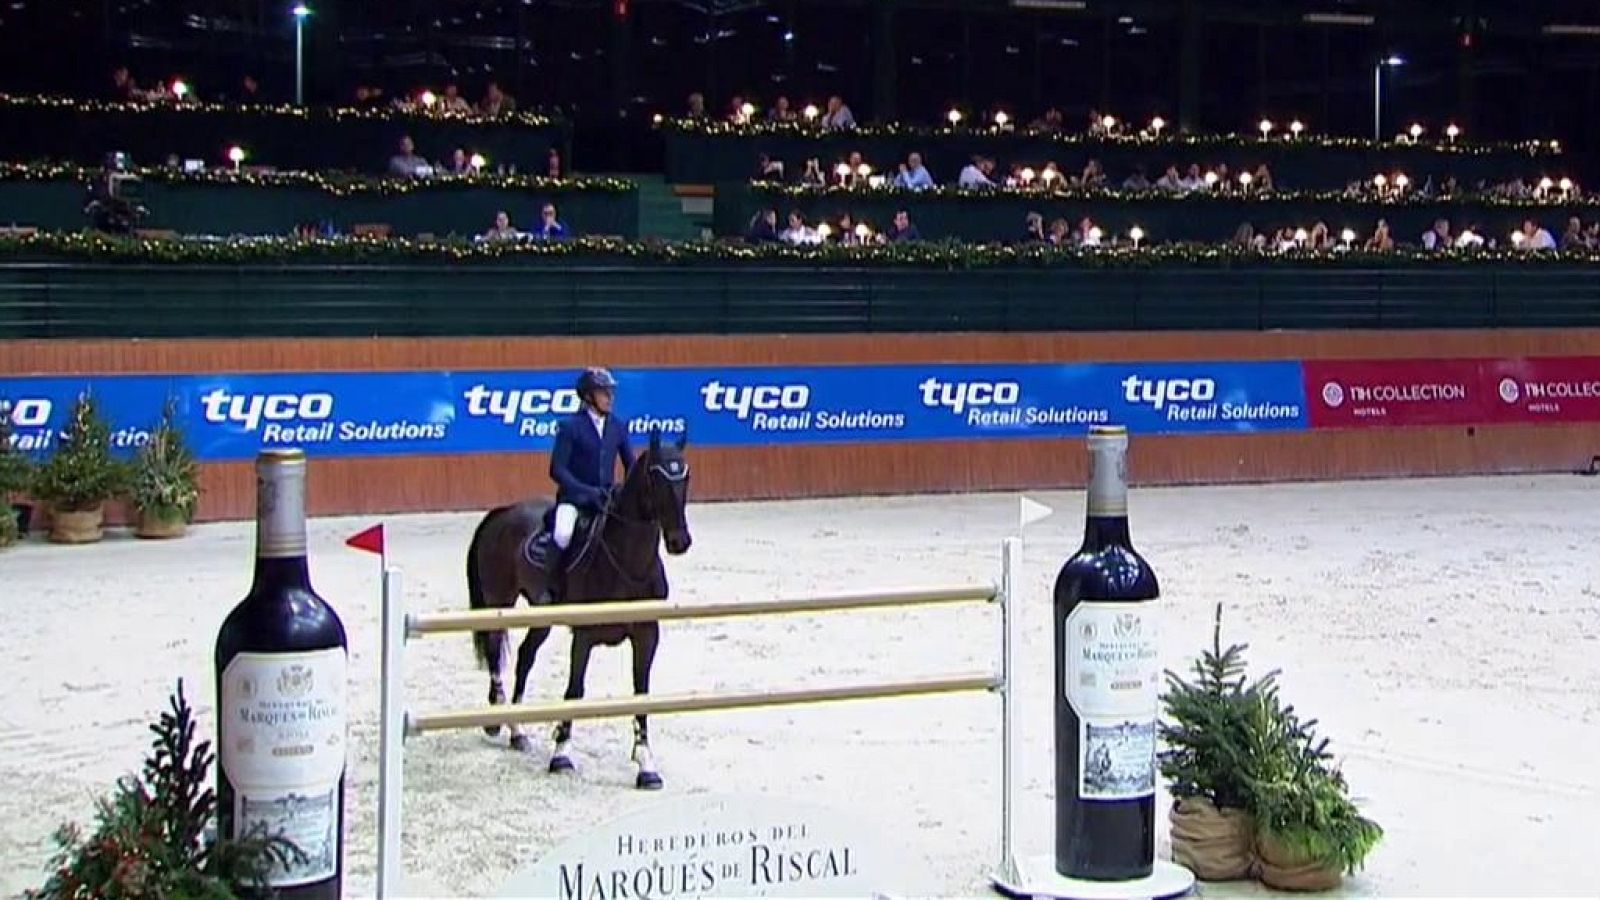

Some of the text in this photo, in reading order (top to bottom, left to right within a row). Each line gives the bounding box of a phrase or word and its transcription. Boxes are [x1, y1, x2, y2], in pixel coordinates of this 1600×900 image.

[464, 384, 582, 424] tyco
[701, 380, 810, 419] tyco
[919, 377, 1020, 415] tyco
[1122, 374, 1215, 410] tyco
[1373, 383, 1465, 401] COLLECTION
[201, 388, 333, 431] tyco
[753, 409, 905, 431] Retail Solutions
[968, 405, 1109, 426] Retail Solutions
[1167, 401, 1300, 421] Retail Solutions
[263, 420, 446, 443] Retail Solutions
[617, 823, 811, 856] HEREDEROS DEL
[558, 843, 857, 900] MARQUÉS DE RISCAL
